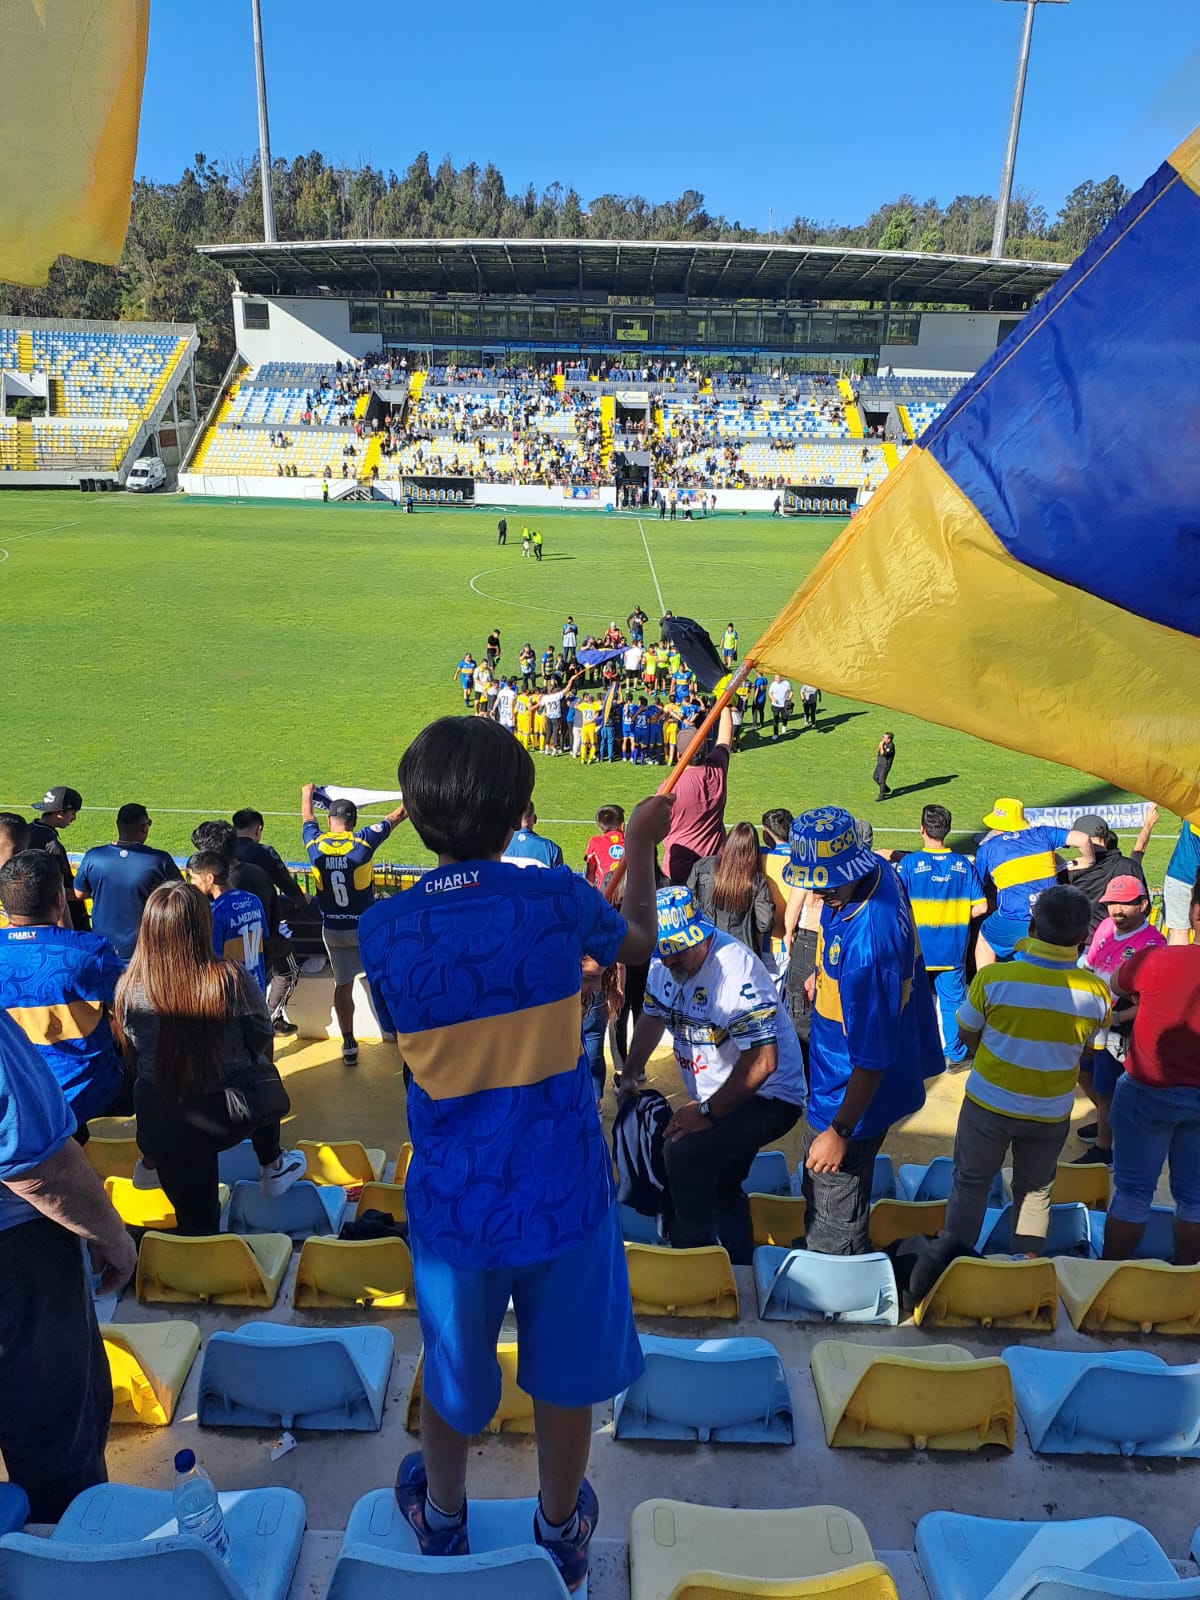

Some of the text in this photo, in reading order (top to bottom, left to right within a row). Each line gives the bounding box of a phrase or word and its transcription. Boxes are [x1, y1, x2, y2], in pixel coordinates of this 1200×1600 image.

[611, 845, 624, 858] hp
[325, 856, 348, 870] ARIAS
[330, 870, 349, 908] 6
[425, 870, 480, 893] CHARLY
[8, 931, 37, 941] CHARLY
[659, 925, 704, 956] CIELO
